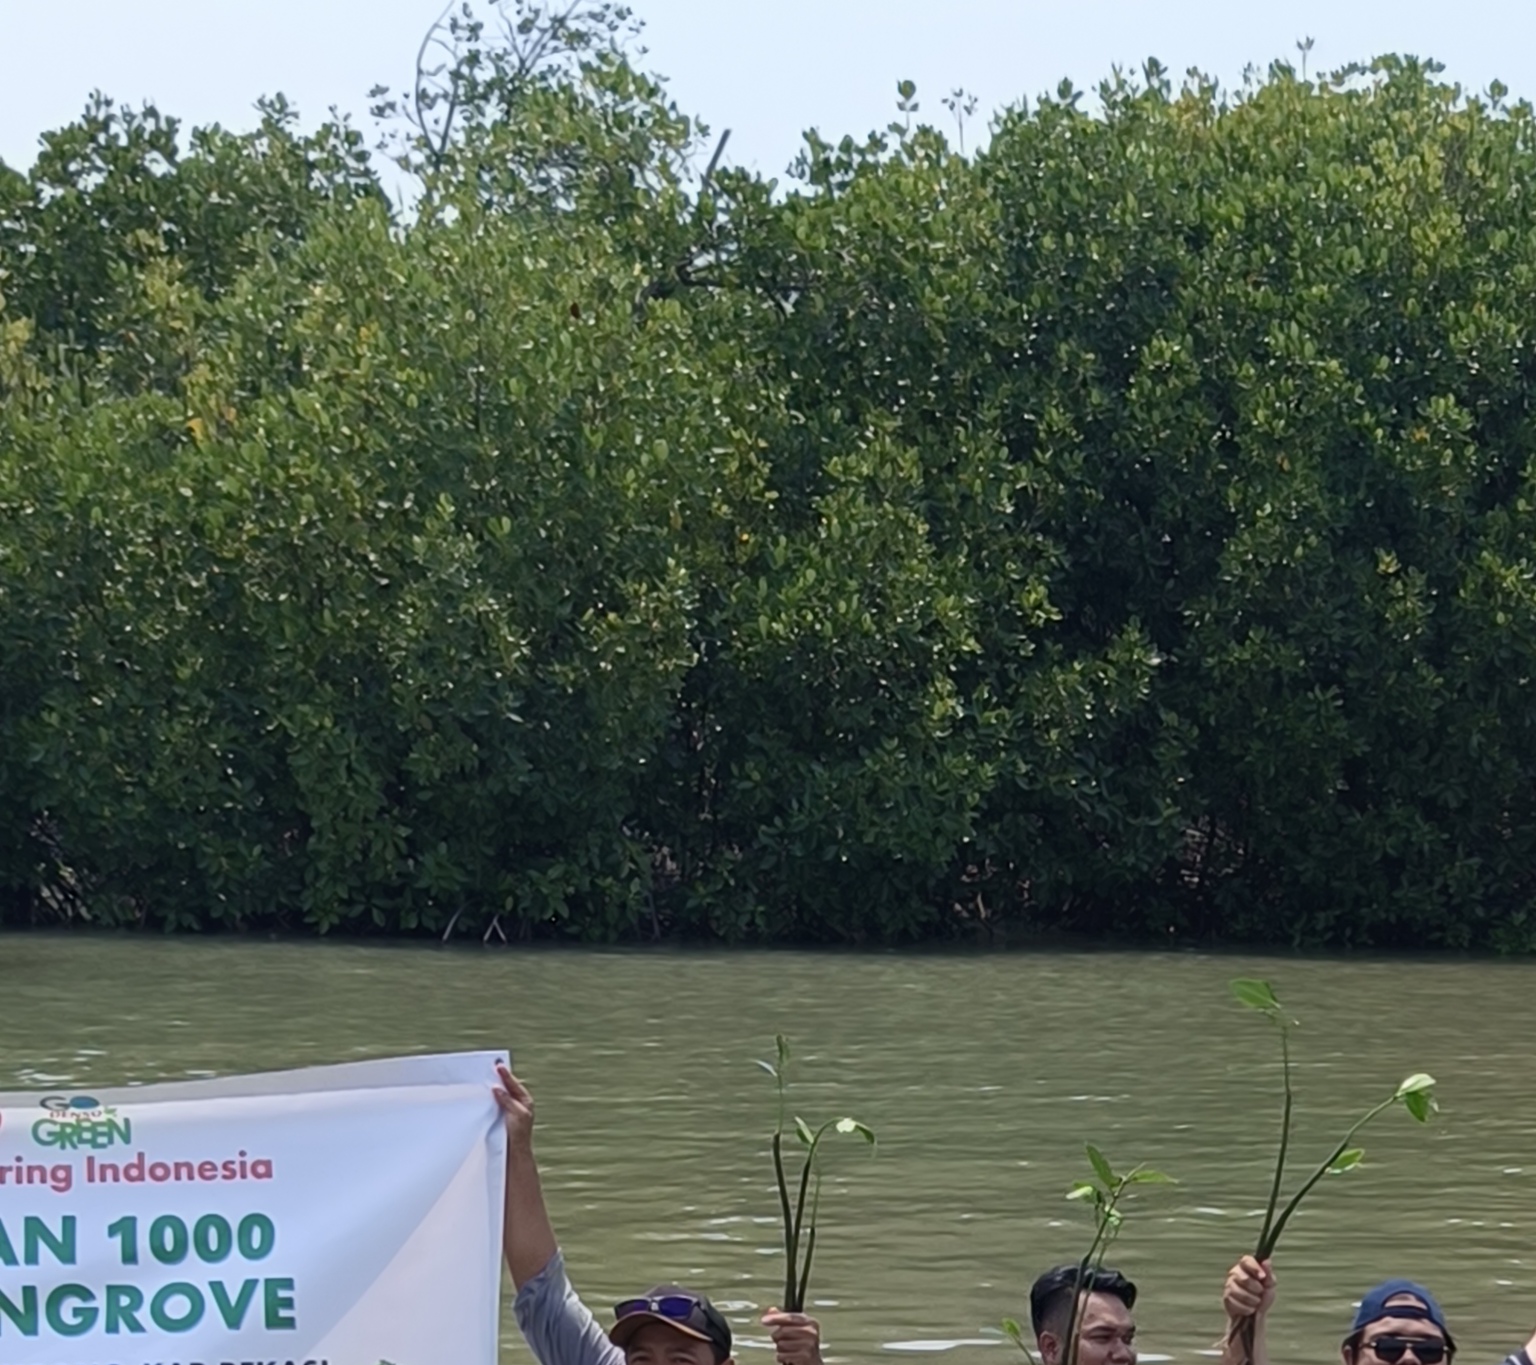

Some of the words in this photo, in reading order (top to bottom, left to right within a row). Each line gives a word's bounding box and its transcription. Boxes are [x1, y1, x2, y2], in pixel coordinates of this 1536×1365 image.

[31, 1117, 132, 1150] GREEN
[86, 1150, 273, 1183] Indonesia
[107, 1213, 275, 1266] 1000
